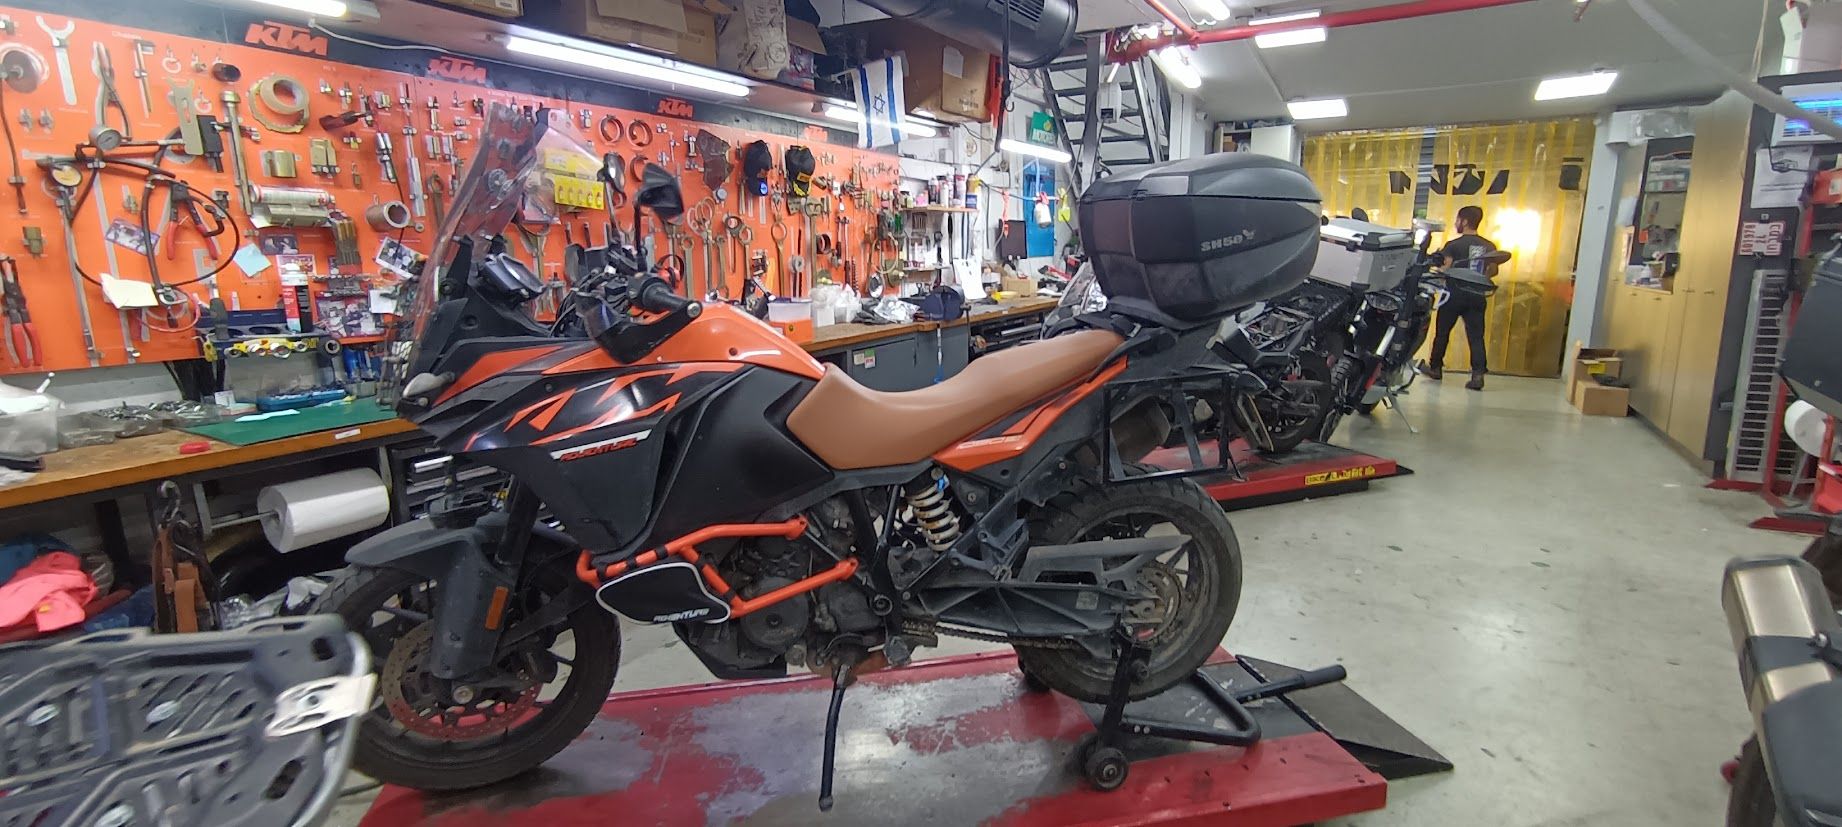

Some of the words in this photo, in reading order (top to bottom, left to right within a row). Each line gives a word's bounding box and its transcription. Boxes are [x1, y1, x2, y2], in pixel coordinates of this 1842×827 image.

[245, 20, 328, 56] KTM
[428, 56, 487, 84] KTM
[657, 98, 694, 118] KTM
[560, 437, 638, 462] ADVENTURE
[653, 608, 710, 622] ADVENTURE
